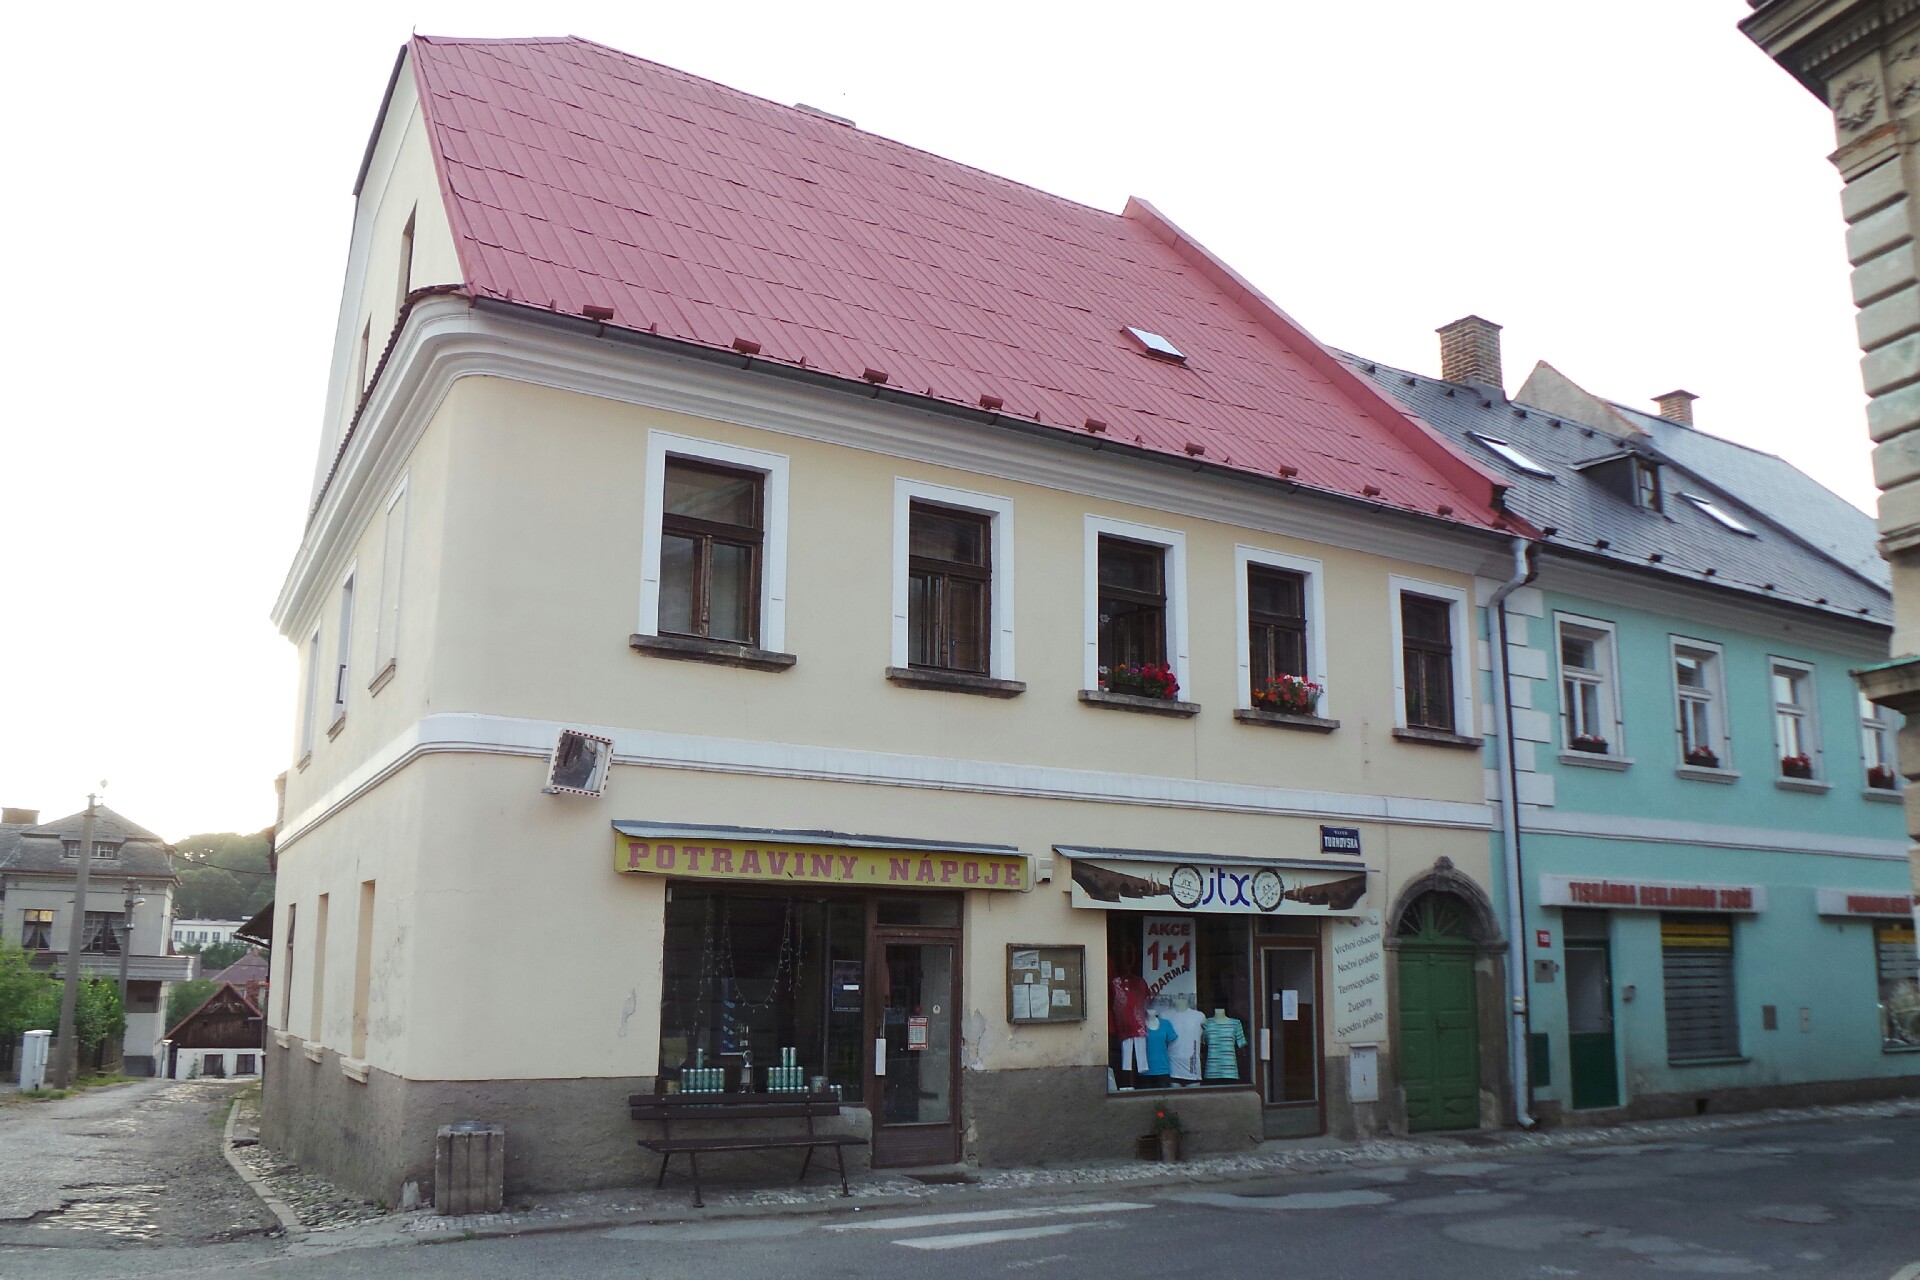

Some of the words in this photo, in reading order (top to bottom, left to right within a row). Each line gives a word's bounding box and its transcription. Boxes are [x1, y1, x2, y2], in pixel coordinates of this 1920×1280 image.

[1324, 836, 1358, 849] TURNOVSKÁ
[627, 842, 858, 879] POTRAVINY
[888, 853, 1021, 886] NÁPOJE
[1202, 867, 1250, 907] jtx
[1148, 923, 1190, 936] AKCE
[1147, 941, 1190, 971] 1+1
[1337, 957, 1358, 974] Noční
[1338, 972, 1380, 994] Termoprádlo
[1337, 1019, 1362, 1037] Spodní
